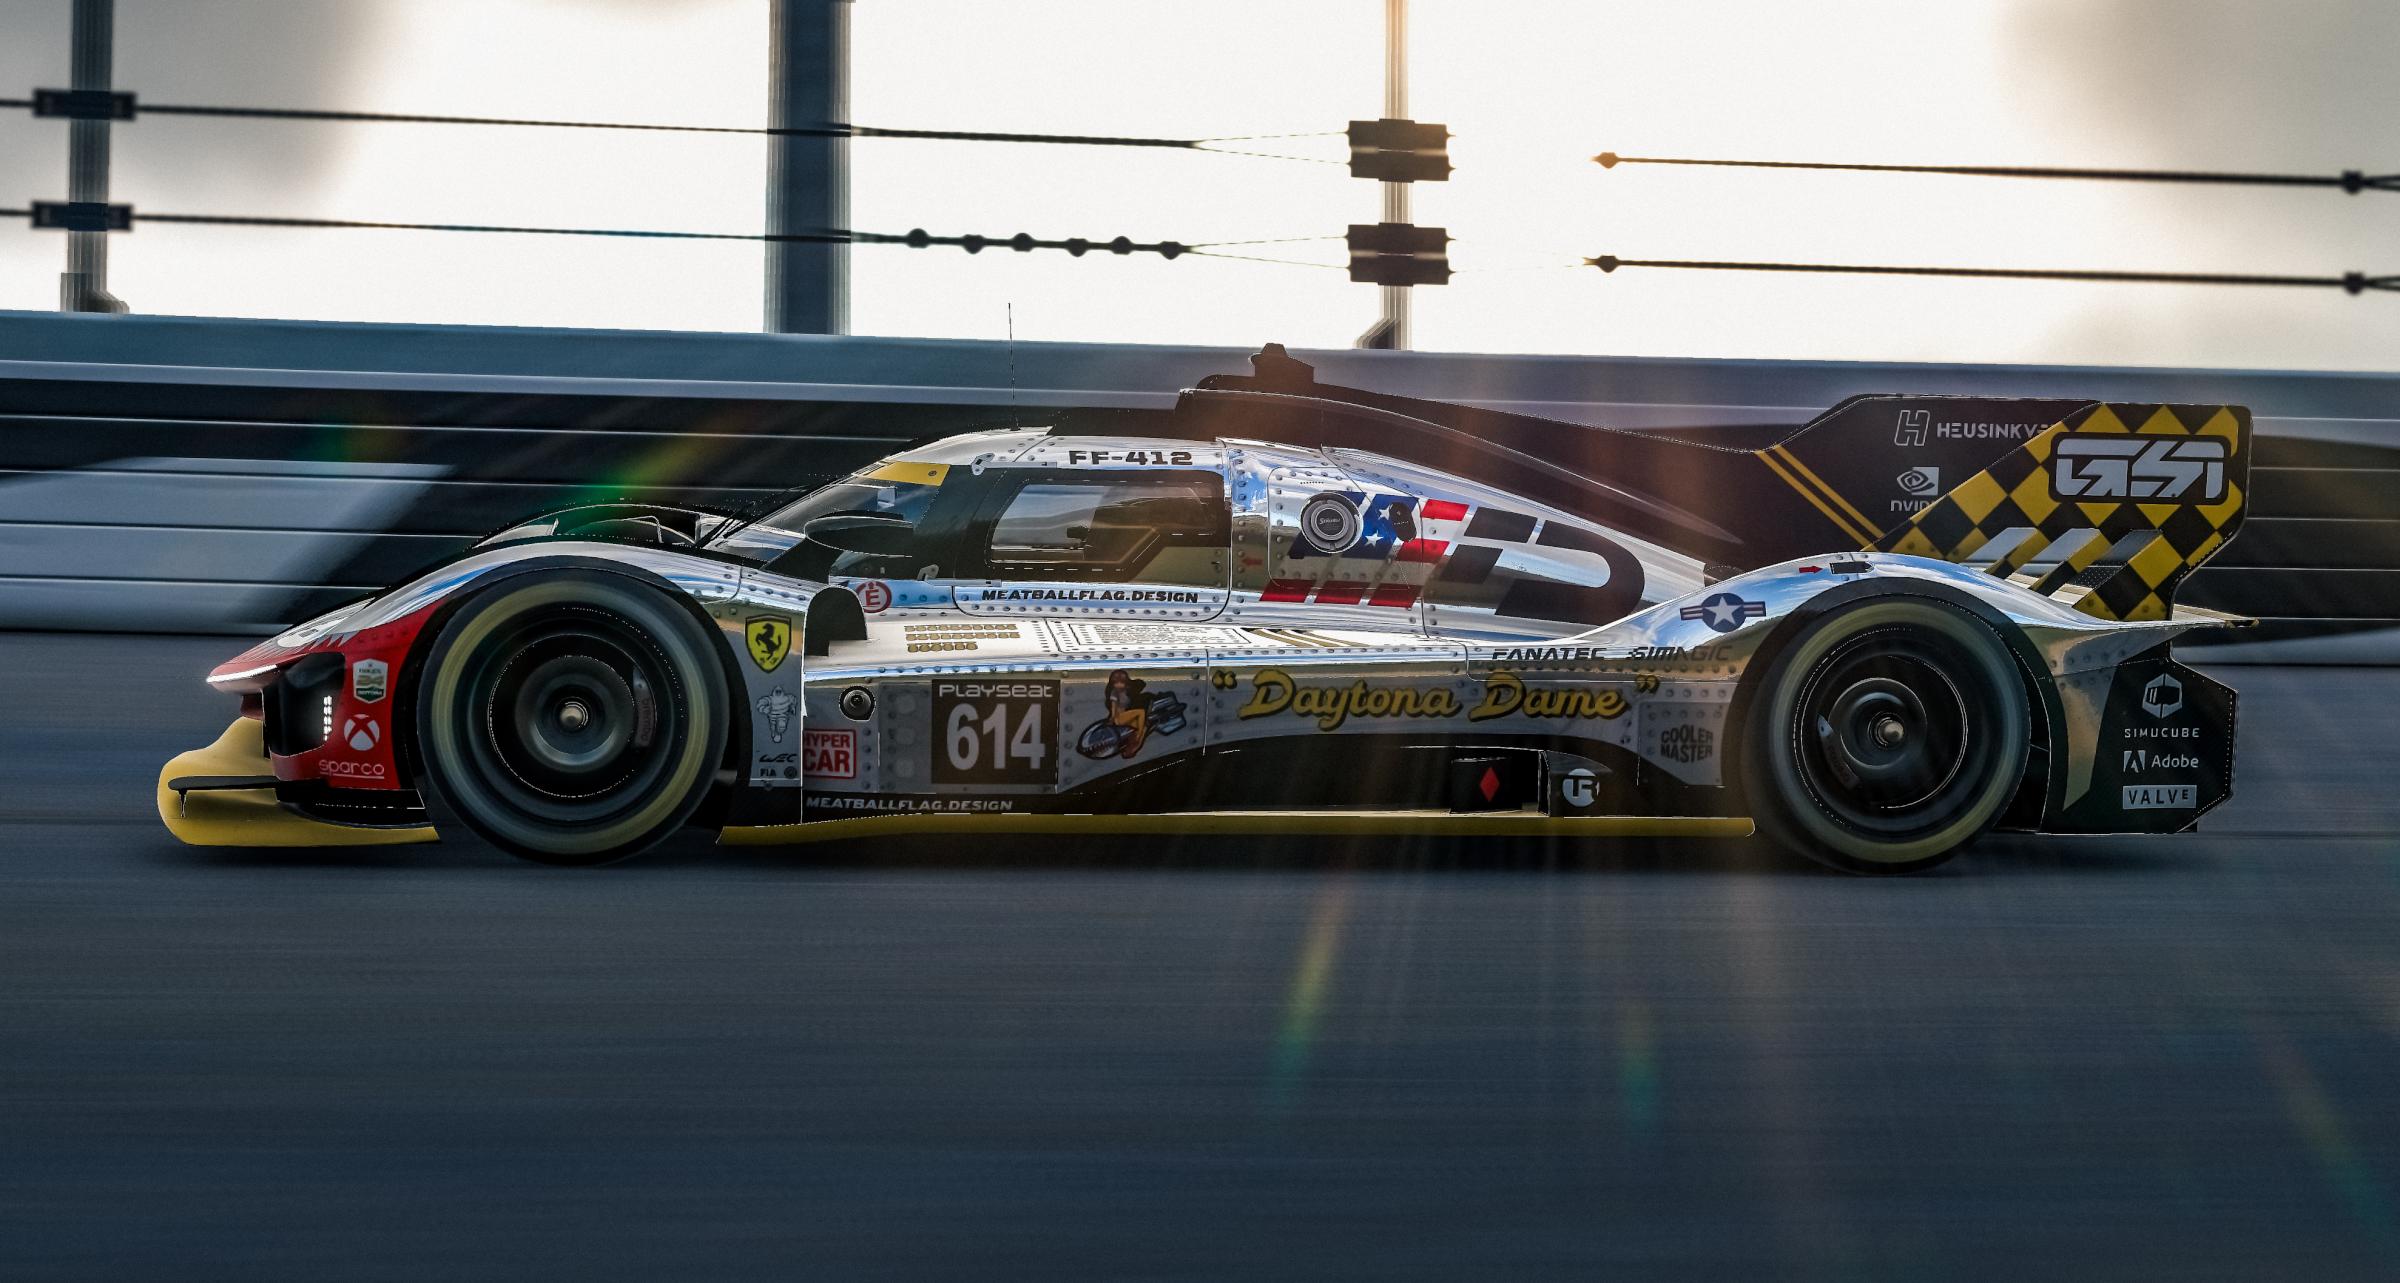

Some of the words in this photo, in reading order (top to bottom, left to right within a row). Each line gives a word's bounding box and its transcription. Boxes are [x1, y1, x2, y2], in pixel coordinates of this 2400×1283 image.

[1069, 450, 1193, 465] FF-412
[981, 588, 1198, 604] MEATBALLFLAG.DESIGN
[1492, 647, 1607, 660] FANATEC
[1626, 645, 1733, 661] SIMAGIC
[946, 702, 1046, 771] 614
[1660, 724, 1714, 744] COOLER
[2124, 727, 2200, 738] SIMUCUBE
[803, 748, 850, 772] CAR
[1660, 743, 1714, 763] MASTER
[2151, 753, 2200, 768] Adobe
[319, 759, 385, 776] sparco
[760, 767, 777, 777] FIA
[806, 797, 1013, 811] MEATBALLFLAG.DESIGN
[2128, 788, 2189, 805] VALVE
